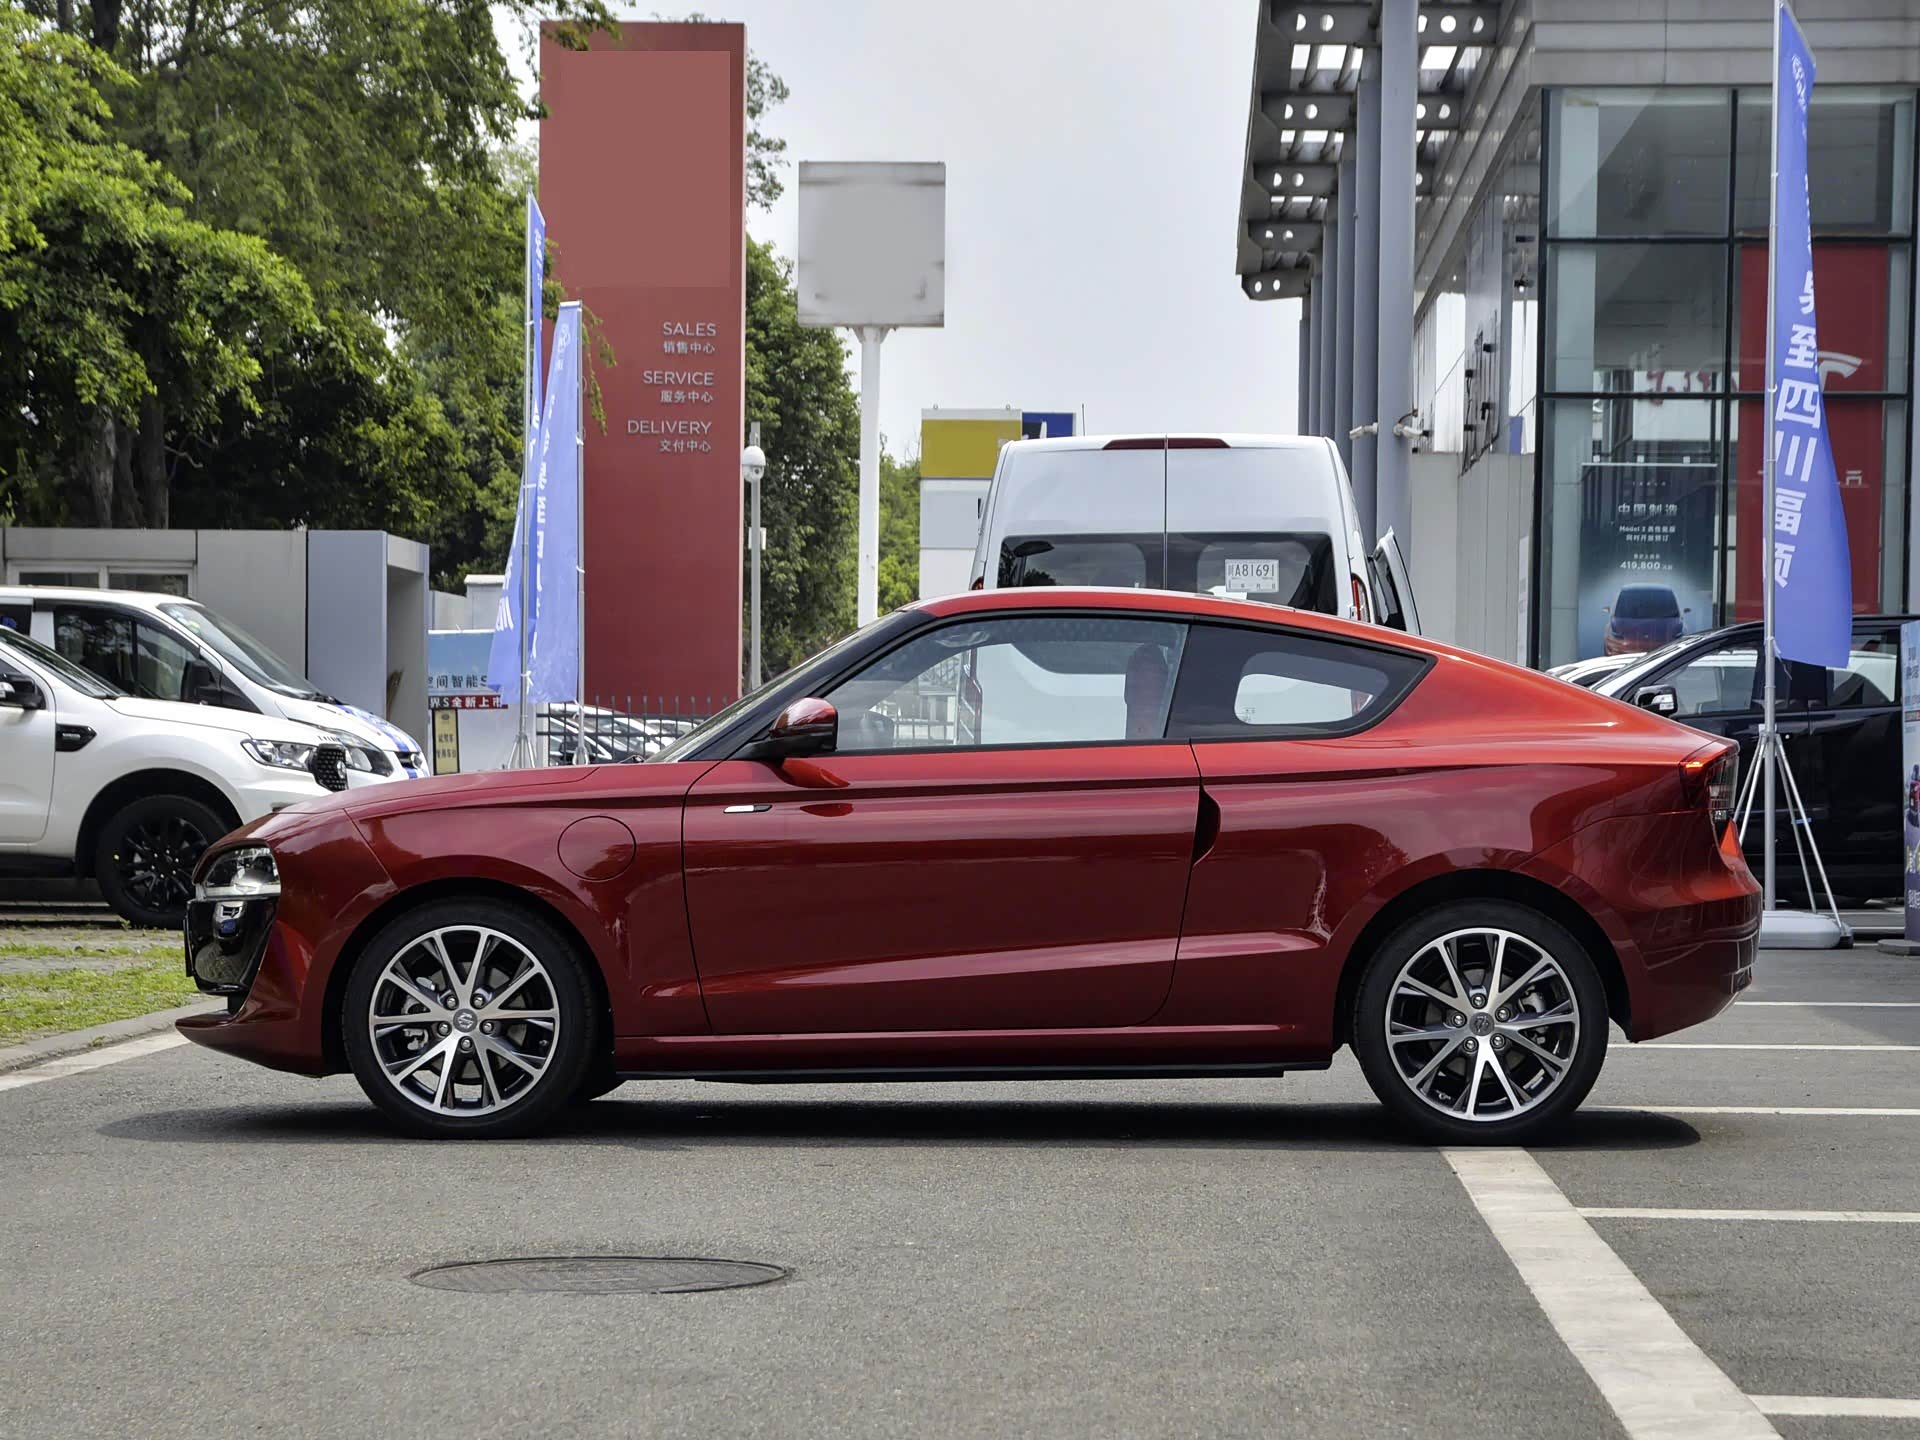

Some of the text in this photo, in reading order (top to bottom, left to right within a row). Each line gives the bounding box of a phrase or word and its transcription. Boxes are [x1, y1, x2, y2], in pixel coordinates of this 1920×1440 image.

[663, 321, 717, 337] SALES
[663, 341, 715, 354] 销售中心
[643, 370, 714, 386] SERVICE
[660, 390, 713, 403] 服务中心
[627, 419, 712, 434] DELIVERY
[659, 439, 711, 452] 交付中心
